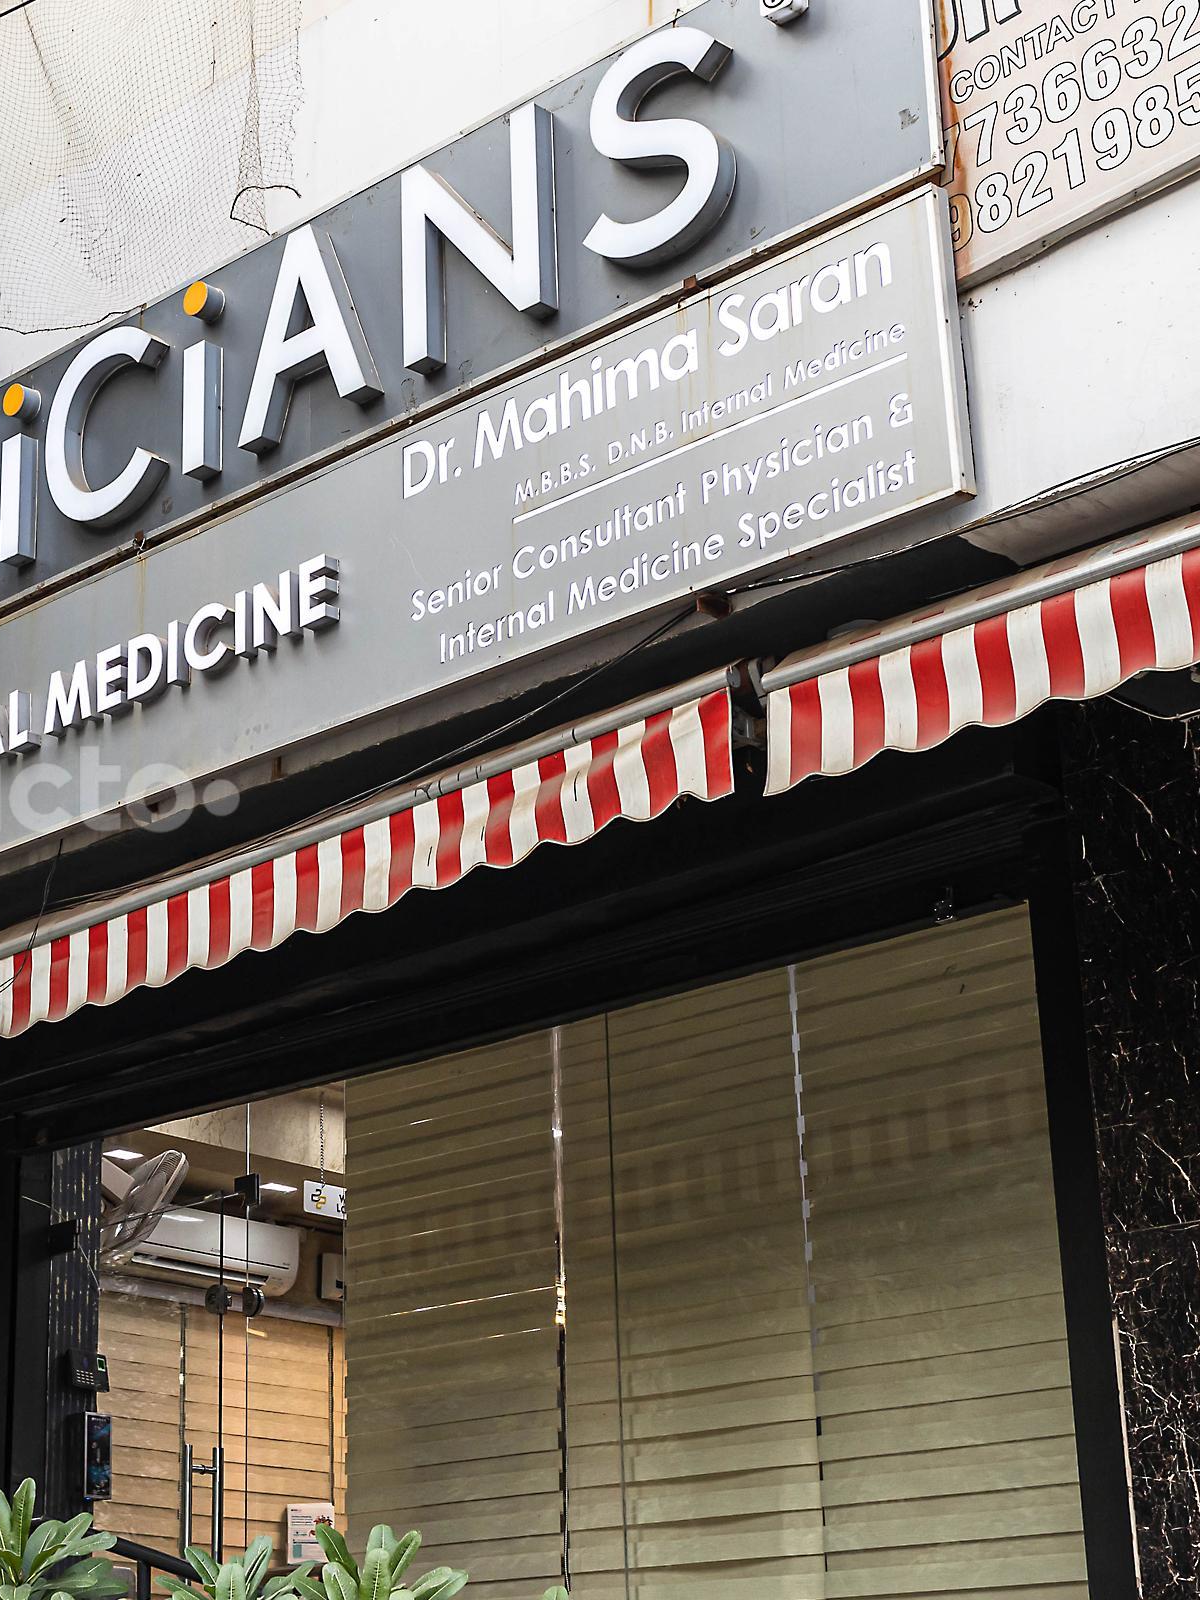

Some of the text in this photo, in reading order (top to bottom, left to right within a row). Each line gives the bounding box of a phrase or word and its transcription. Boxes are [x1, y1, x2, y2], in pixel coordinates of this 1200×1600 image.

[402, 240, 893, 500] Dr. Mahima Saran
[512, 321, 906, 505] M.B.B.S. D.N.B. Internal Medicine
[410, 393, 914, 621] Senior Consultant Physician &
[439, 448, 918, 664] Internal Medicine Specialist
[44, 553, 340, 736] MEDICINE
